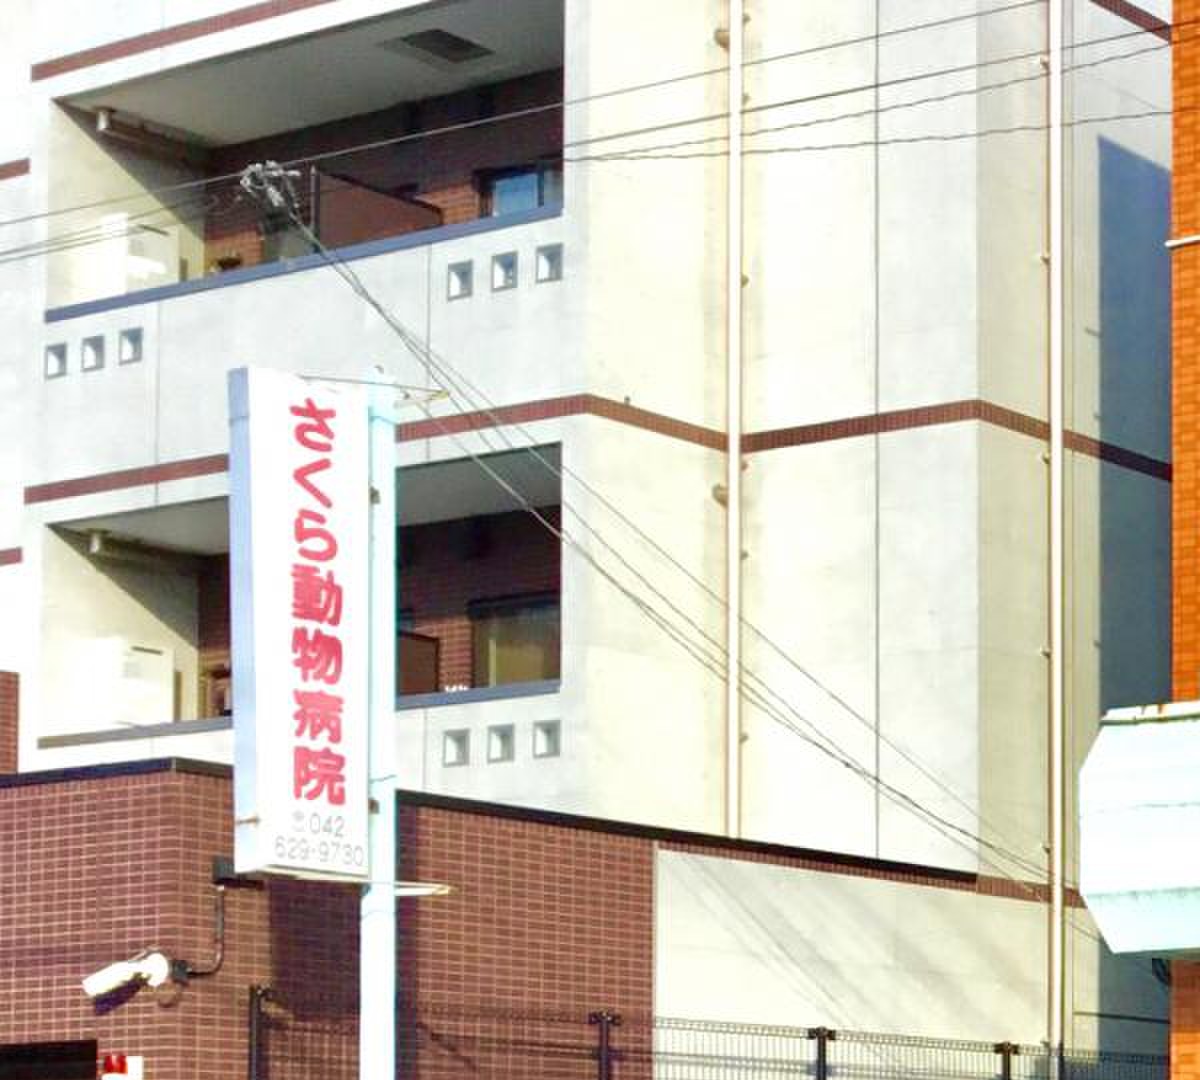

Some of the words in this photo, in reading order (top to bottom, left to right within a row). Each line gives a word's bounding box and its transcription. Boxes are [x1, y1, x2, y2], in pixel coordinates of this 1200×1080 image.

[290, 397, 347, 806] さくら動物病院
[309, 812, 345, 838] 042
